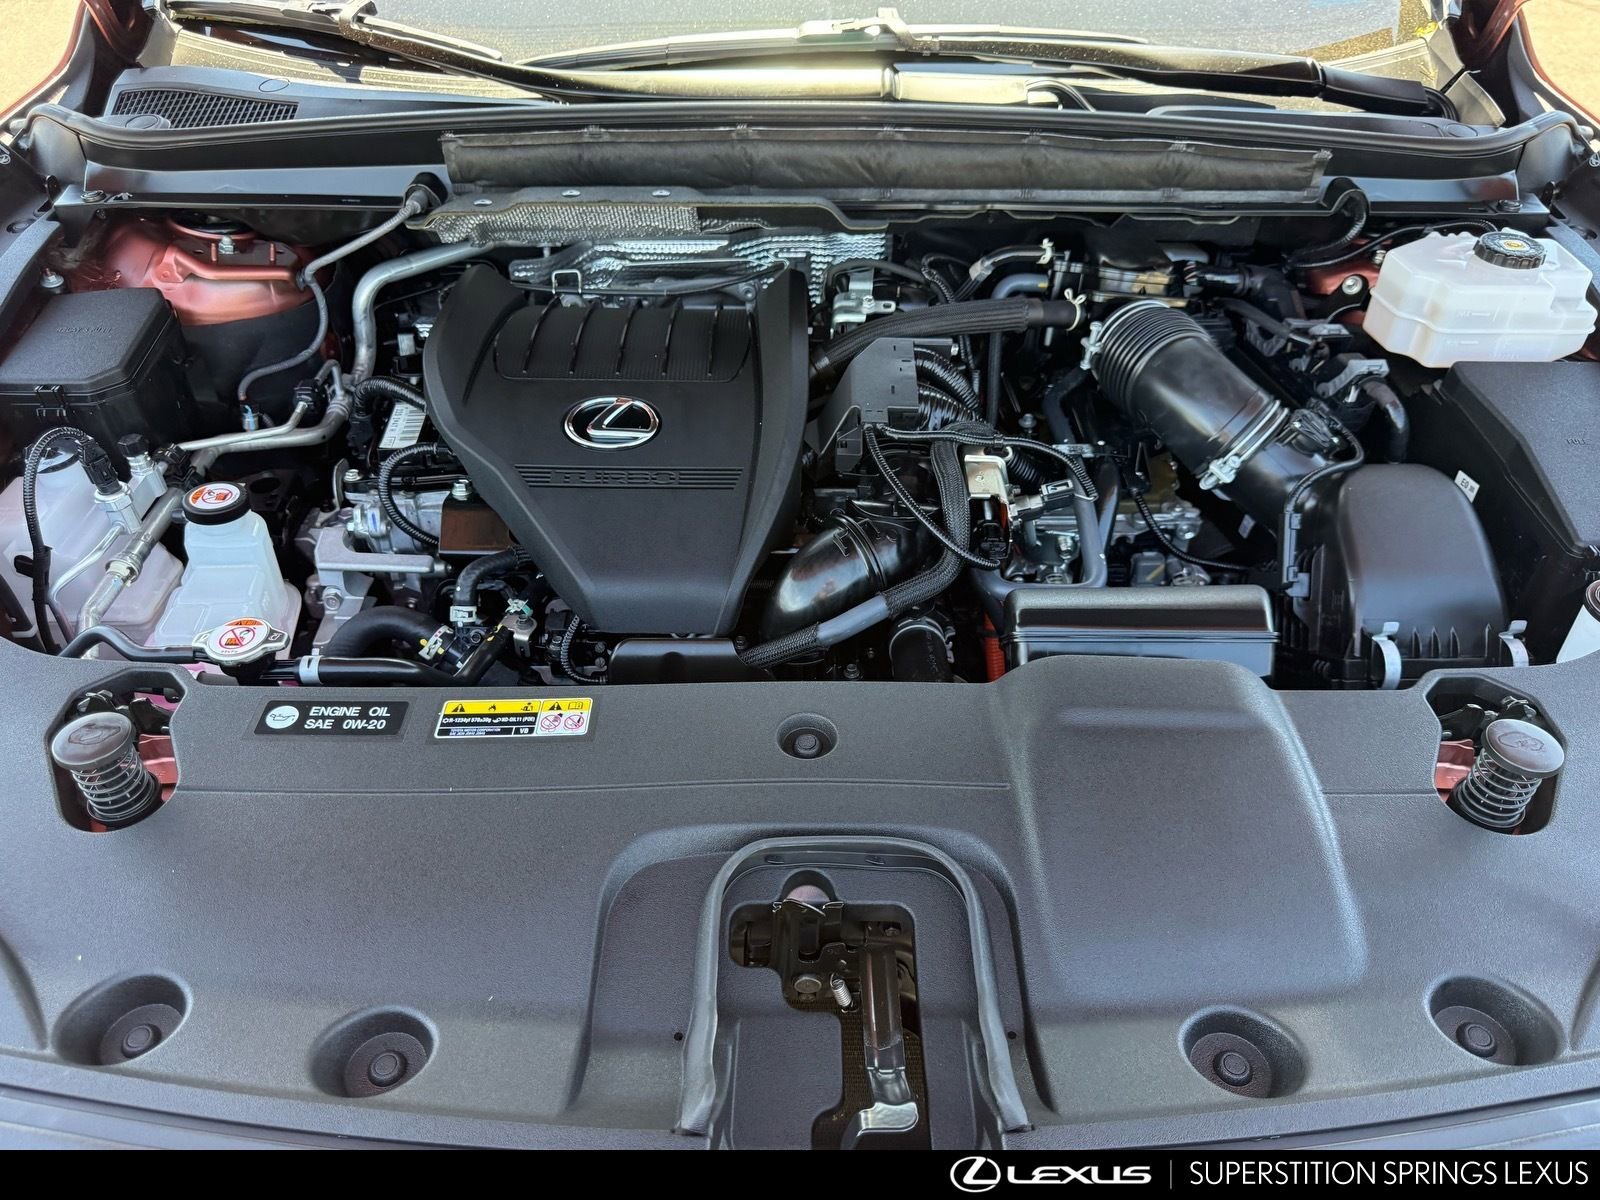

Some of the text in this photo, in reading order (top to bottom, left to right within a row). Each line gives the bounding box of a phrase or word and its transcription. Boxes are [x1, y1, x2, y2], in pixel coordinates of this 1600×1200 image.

[552, 469, 677, 485] TURBO
[309, 706, 391, 717] ENGINE OIL
[304, 719, 387, 730] SAE 0W-20
